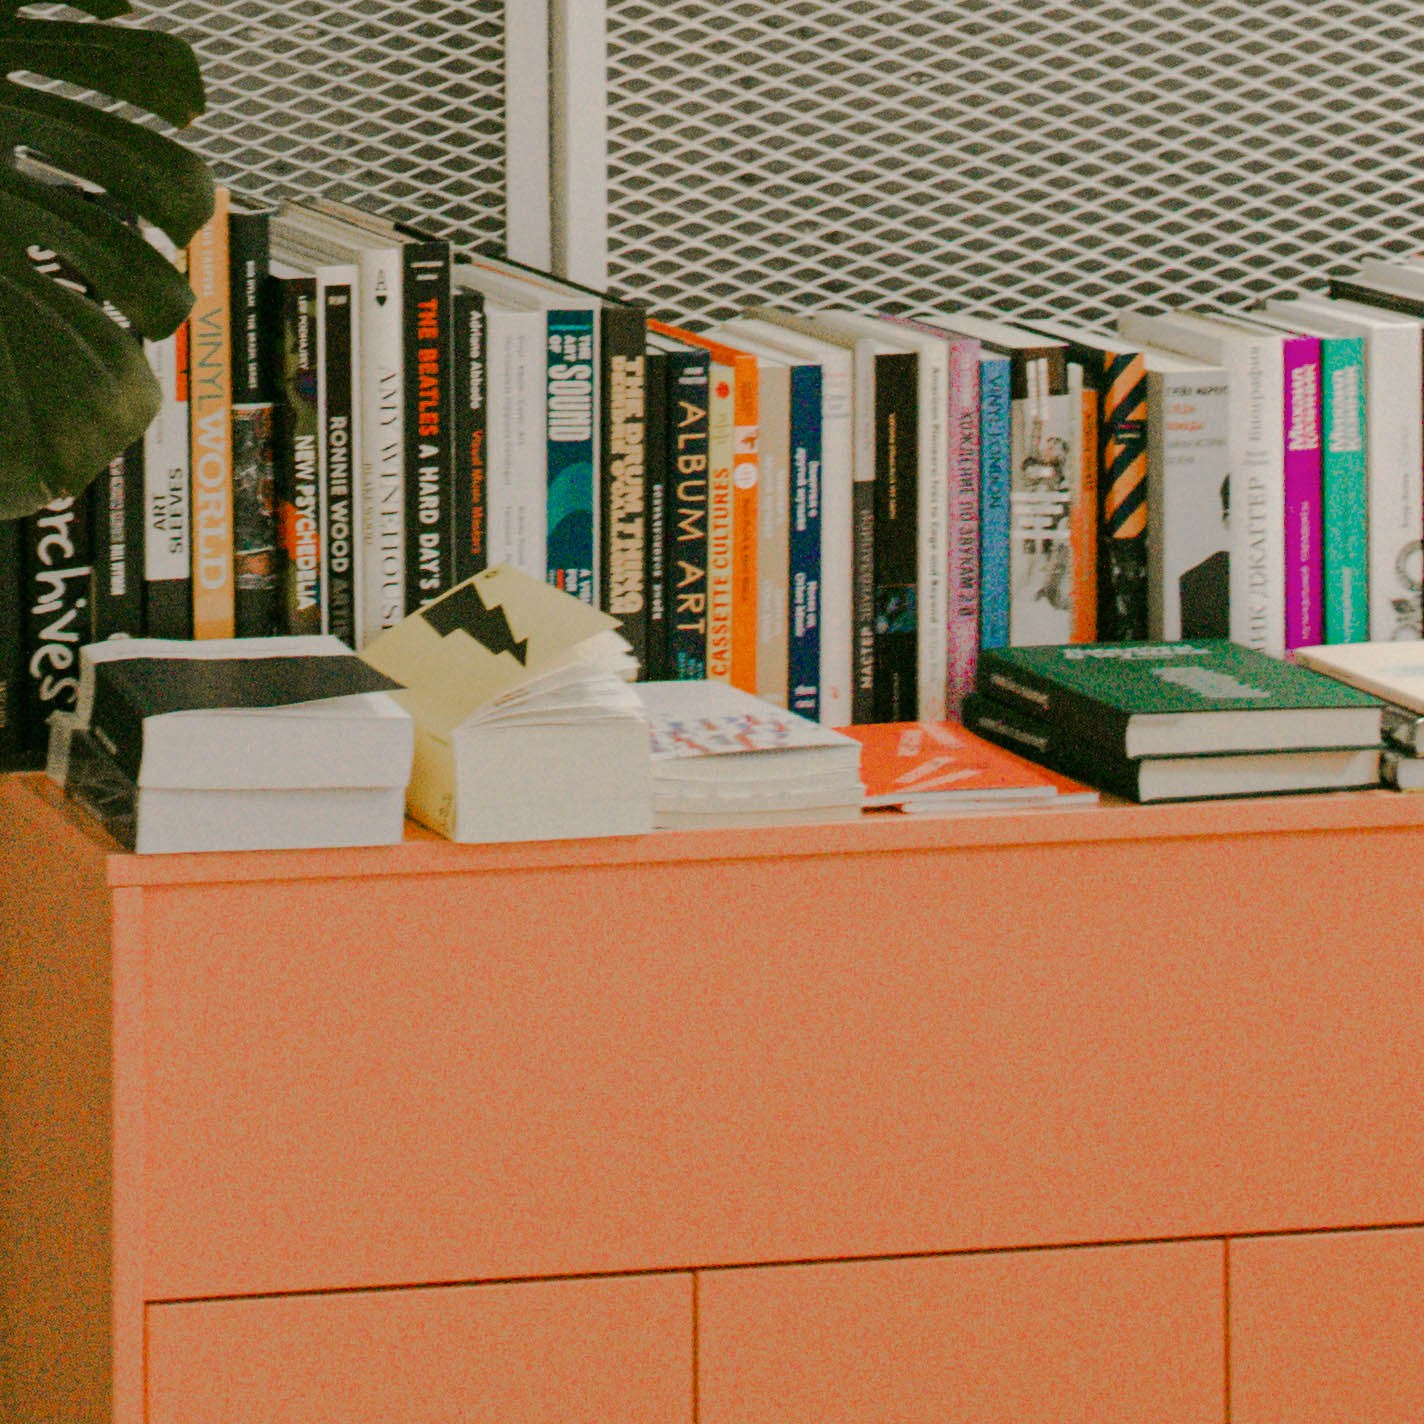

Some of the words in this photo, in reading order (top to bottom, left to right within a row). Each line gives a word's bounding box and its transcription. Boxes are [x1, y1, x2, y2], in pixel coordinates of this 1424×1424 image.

[417, 297, 439, 339] THE
[469, 310, 483, 358] Adriano
[548, 334, 562, 353] OF
[563, 334, 577, 362] ART
[578, 334, 592, 360] THE
[196, 307, 224, 410] VINYL
[417, 348, 439, 436] BEATLES
[624, 355, 644, 419] THE
[1247, 345, 1263, 442] Биография
[380, 366, 400, 427] AMY
[547, 364, 592, 442] SOUND
[987, 373, 1004, 428] VINYL
[1287, 367, 1303, 452] Михаил
[1328, 369, 1345, 453] Михаил
[295, 435, 316, 479] NEW
[329, 416, 348, 496] RONNIE
[418, 443, 439, 455] A
[624, 422, 644, 513] DRUM
[676, 400, 706, 542] ALBUM
[958, 410, 976, 495] ХОЖДЕНИЕ
[988, 431, 1004, 509] LONDON
[152, 493, 167, 531] ART
[168, 468, 183, 554] SLEEVES
[196, 409, 227, 590] WORLD
[418, 466, 439, 524] HARD
[712, 467, 729, 570] CULTURES
[958, 501, 976, 522] ПО
[294, 483, 316, 610] PSYCHEDELIA
[329, 501, 349, 573] WOOD
[419, 533, 441, 590] DAY'S
[624, 516, 644, 614] THING
[958, 527, 976, 589] ЗВУКАМ
[1246, 477, 1269, 599] ДЖАГГЕР
[331, 578, 349, 636] ARTIS
[676, 560, 706, 635] ART
[711, 577, 729, 677] CASSETTE
[859, 626, 873, 689] МАСТЕР
